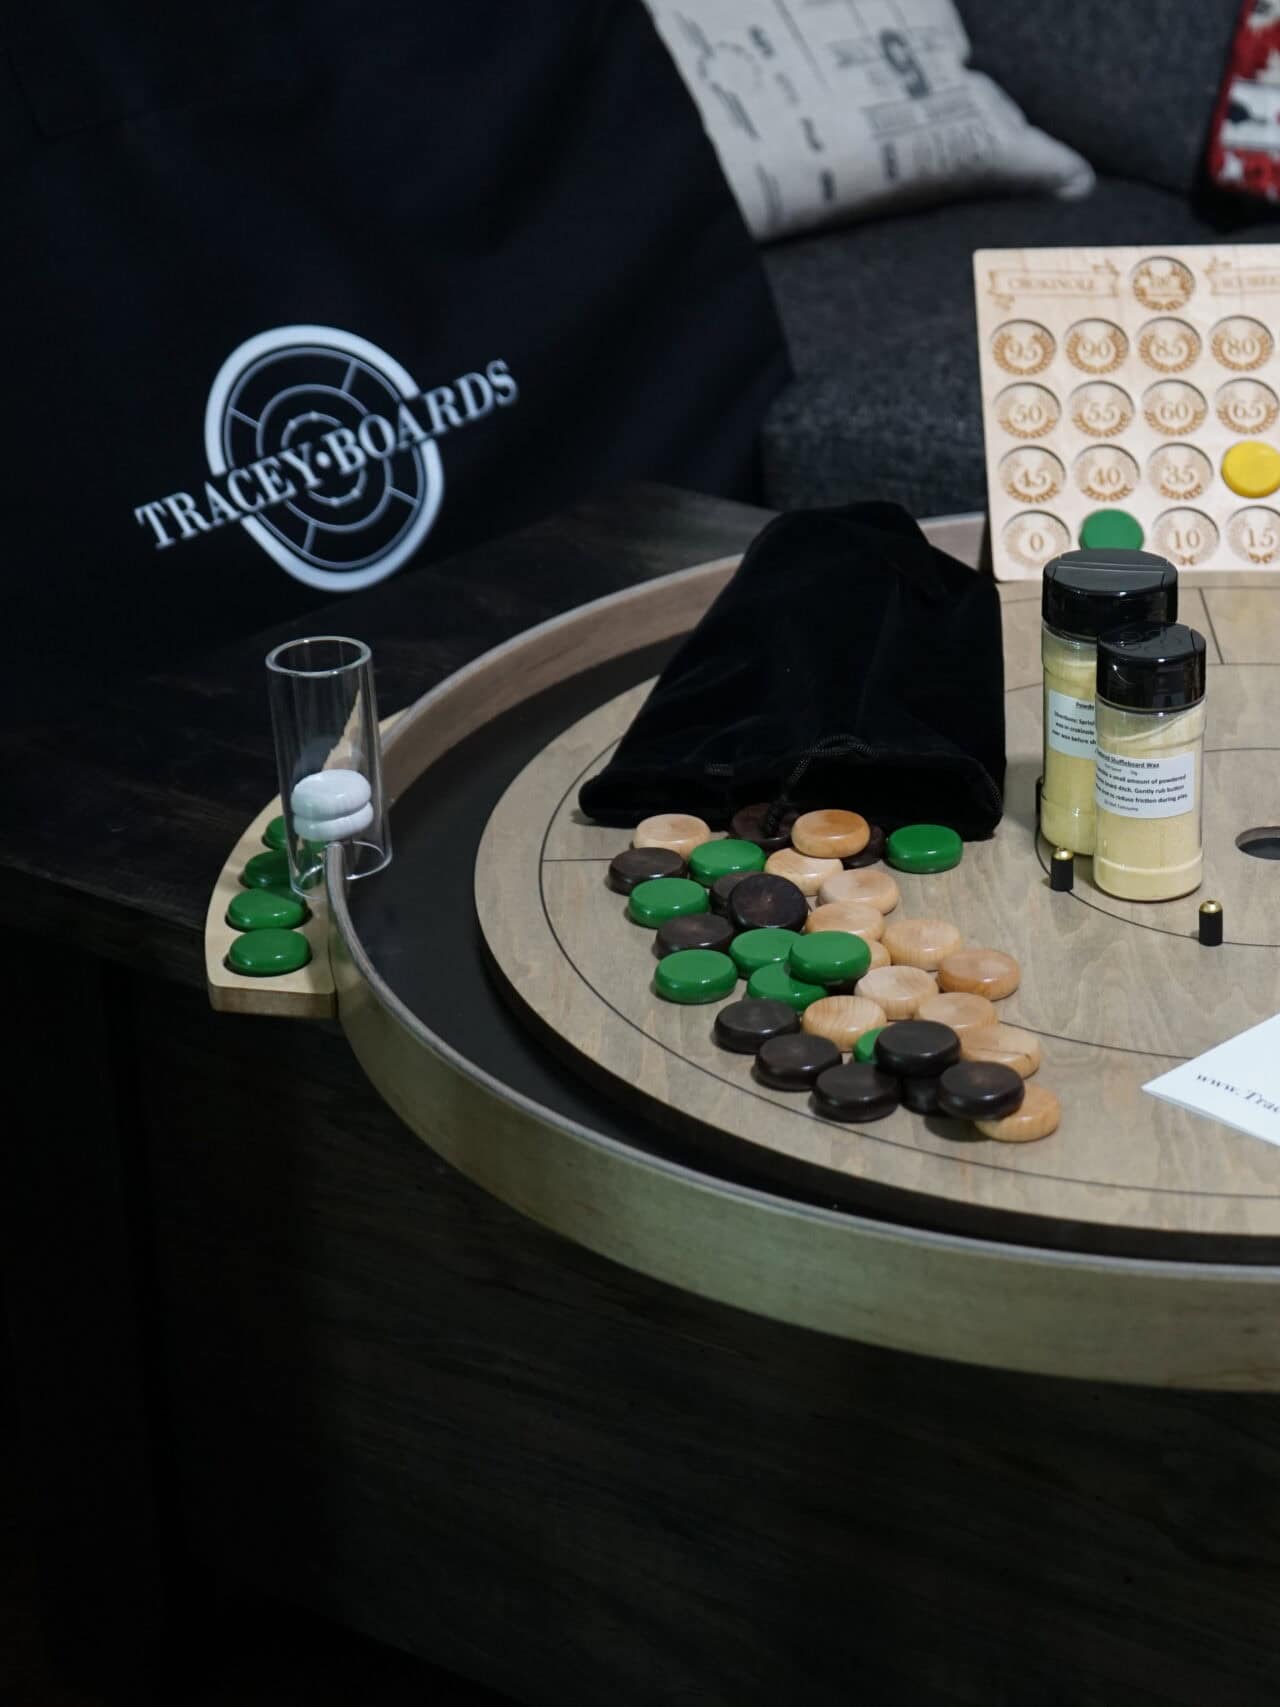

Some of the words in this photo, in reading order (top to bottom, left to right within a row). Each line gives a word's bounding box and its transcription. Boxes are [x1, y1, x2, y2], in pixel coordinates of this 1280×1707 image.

[1009, 341, 1038, 361] 95
[1082, 340, 1111, 359] 90
[1155, 339, 1183, 357] 85
[1227, 338, 1256, 356] 80
[1010, 402, 1042, 423] 50
[1087, 401, 1115, 422] 55
[1160, 402, 1189, 421] 60
[1233, 401, 1262, 420] 65
[134, 441, 322, 550] TRACEY
[324, 358, 519, 476] BOARDS
[1018, 467, 1047, 488] 45
[1094, 467, 1121, 486] 40
[1166, 464, 1195, 484] 35
[1029, 532, 1045, 552] 0
[1173, 529, 1200, 550] 10
[1248, 527, 1275, 548] 15
